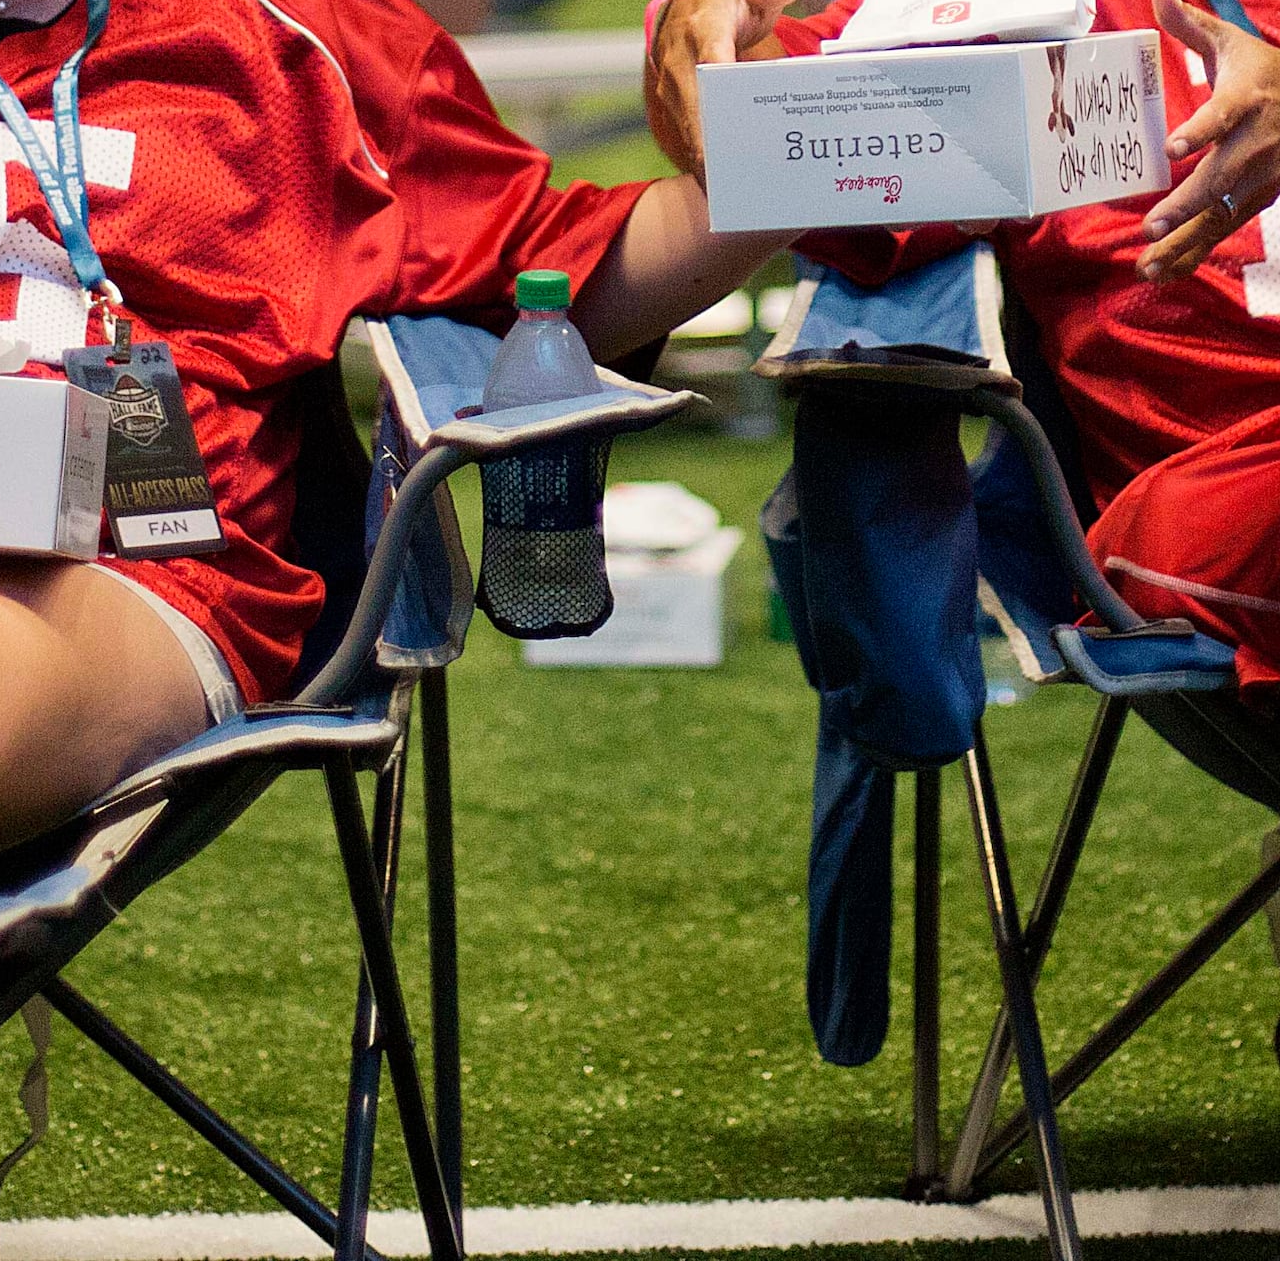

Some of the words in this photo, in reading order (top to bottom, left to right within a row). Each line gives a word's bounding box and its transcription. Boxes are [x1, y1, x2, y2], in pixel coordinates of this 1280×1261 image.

[753, 93, 788, 105] picnics
[790, 92, 825, 103] events,
[826, 89, 868, 102] sporting
[870, 87, 907, 99] parties,
[909, 84, 971, 97] fund-raisers,
[1074, 71, 1112, 126] CHIKIN
[1118, 68, 1138, 123] SAY
[782, 104, 824, 116] lunches,
[826, 102, 858, 115] school
[860, 101, 896, 112] events,
[897, 98, 944, 111] corporate
[58, 114, 79, 175] Football
[785, 131, 945, 167] catering
[25, 143, 51, 171] Hall
[1090, 133, 1108, 181] UP
[1110, 130, 1144, 182] OPEN
[1059, 142, 1086, 194] AND
[40, 172, 60, 187] of
[48, 189, 74, 226] Fame
[140, 348, 166, 364] 22
[109, 401, 132, 420] HALL
[138, 398, 161, 416] FAME
[109, 479, 177, 508] ALL-ACCESS
[175, 475, 209, 503] PASS
[147, 519, 189, 536] FAN
